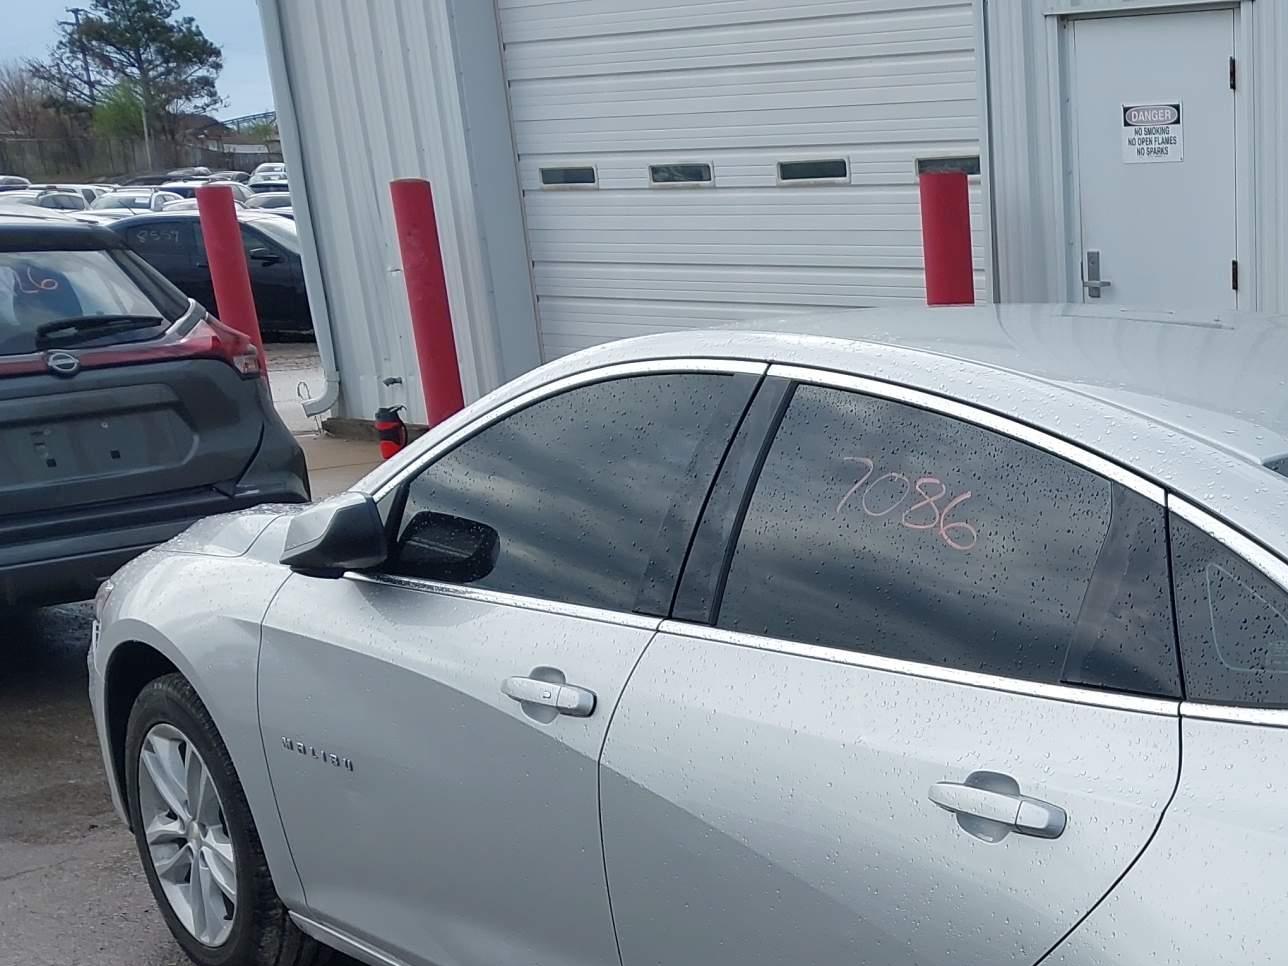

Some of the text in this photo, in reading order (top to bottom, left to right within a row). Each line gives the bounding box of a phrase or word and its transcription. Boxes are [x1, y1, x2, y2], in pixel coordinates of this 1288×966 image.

[1131, 109, 1172, 122] DANGER
[1134, 126, 1170, 136] NO SMOKING
[1127, 135, 1177, 146] NO OPEN FLAMES
[1136, 146, 1169, 156] NO SPARKS
[836, 456, 978, 550] 7086
